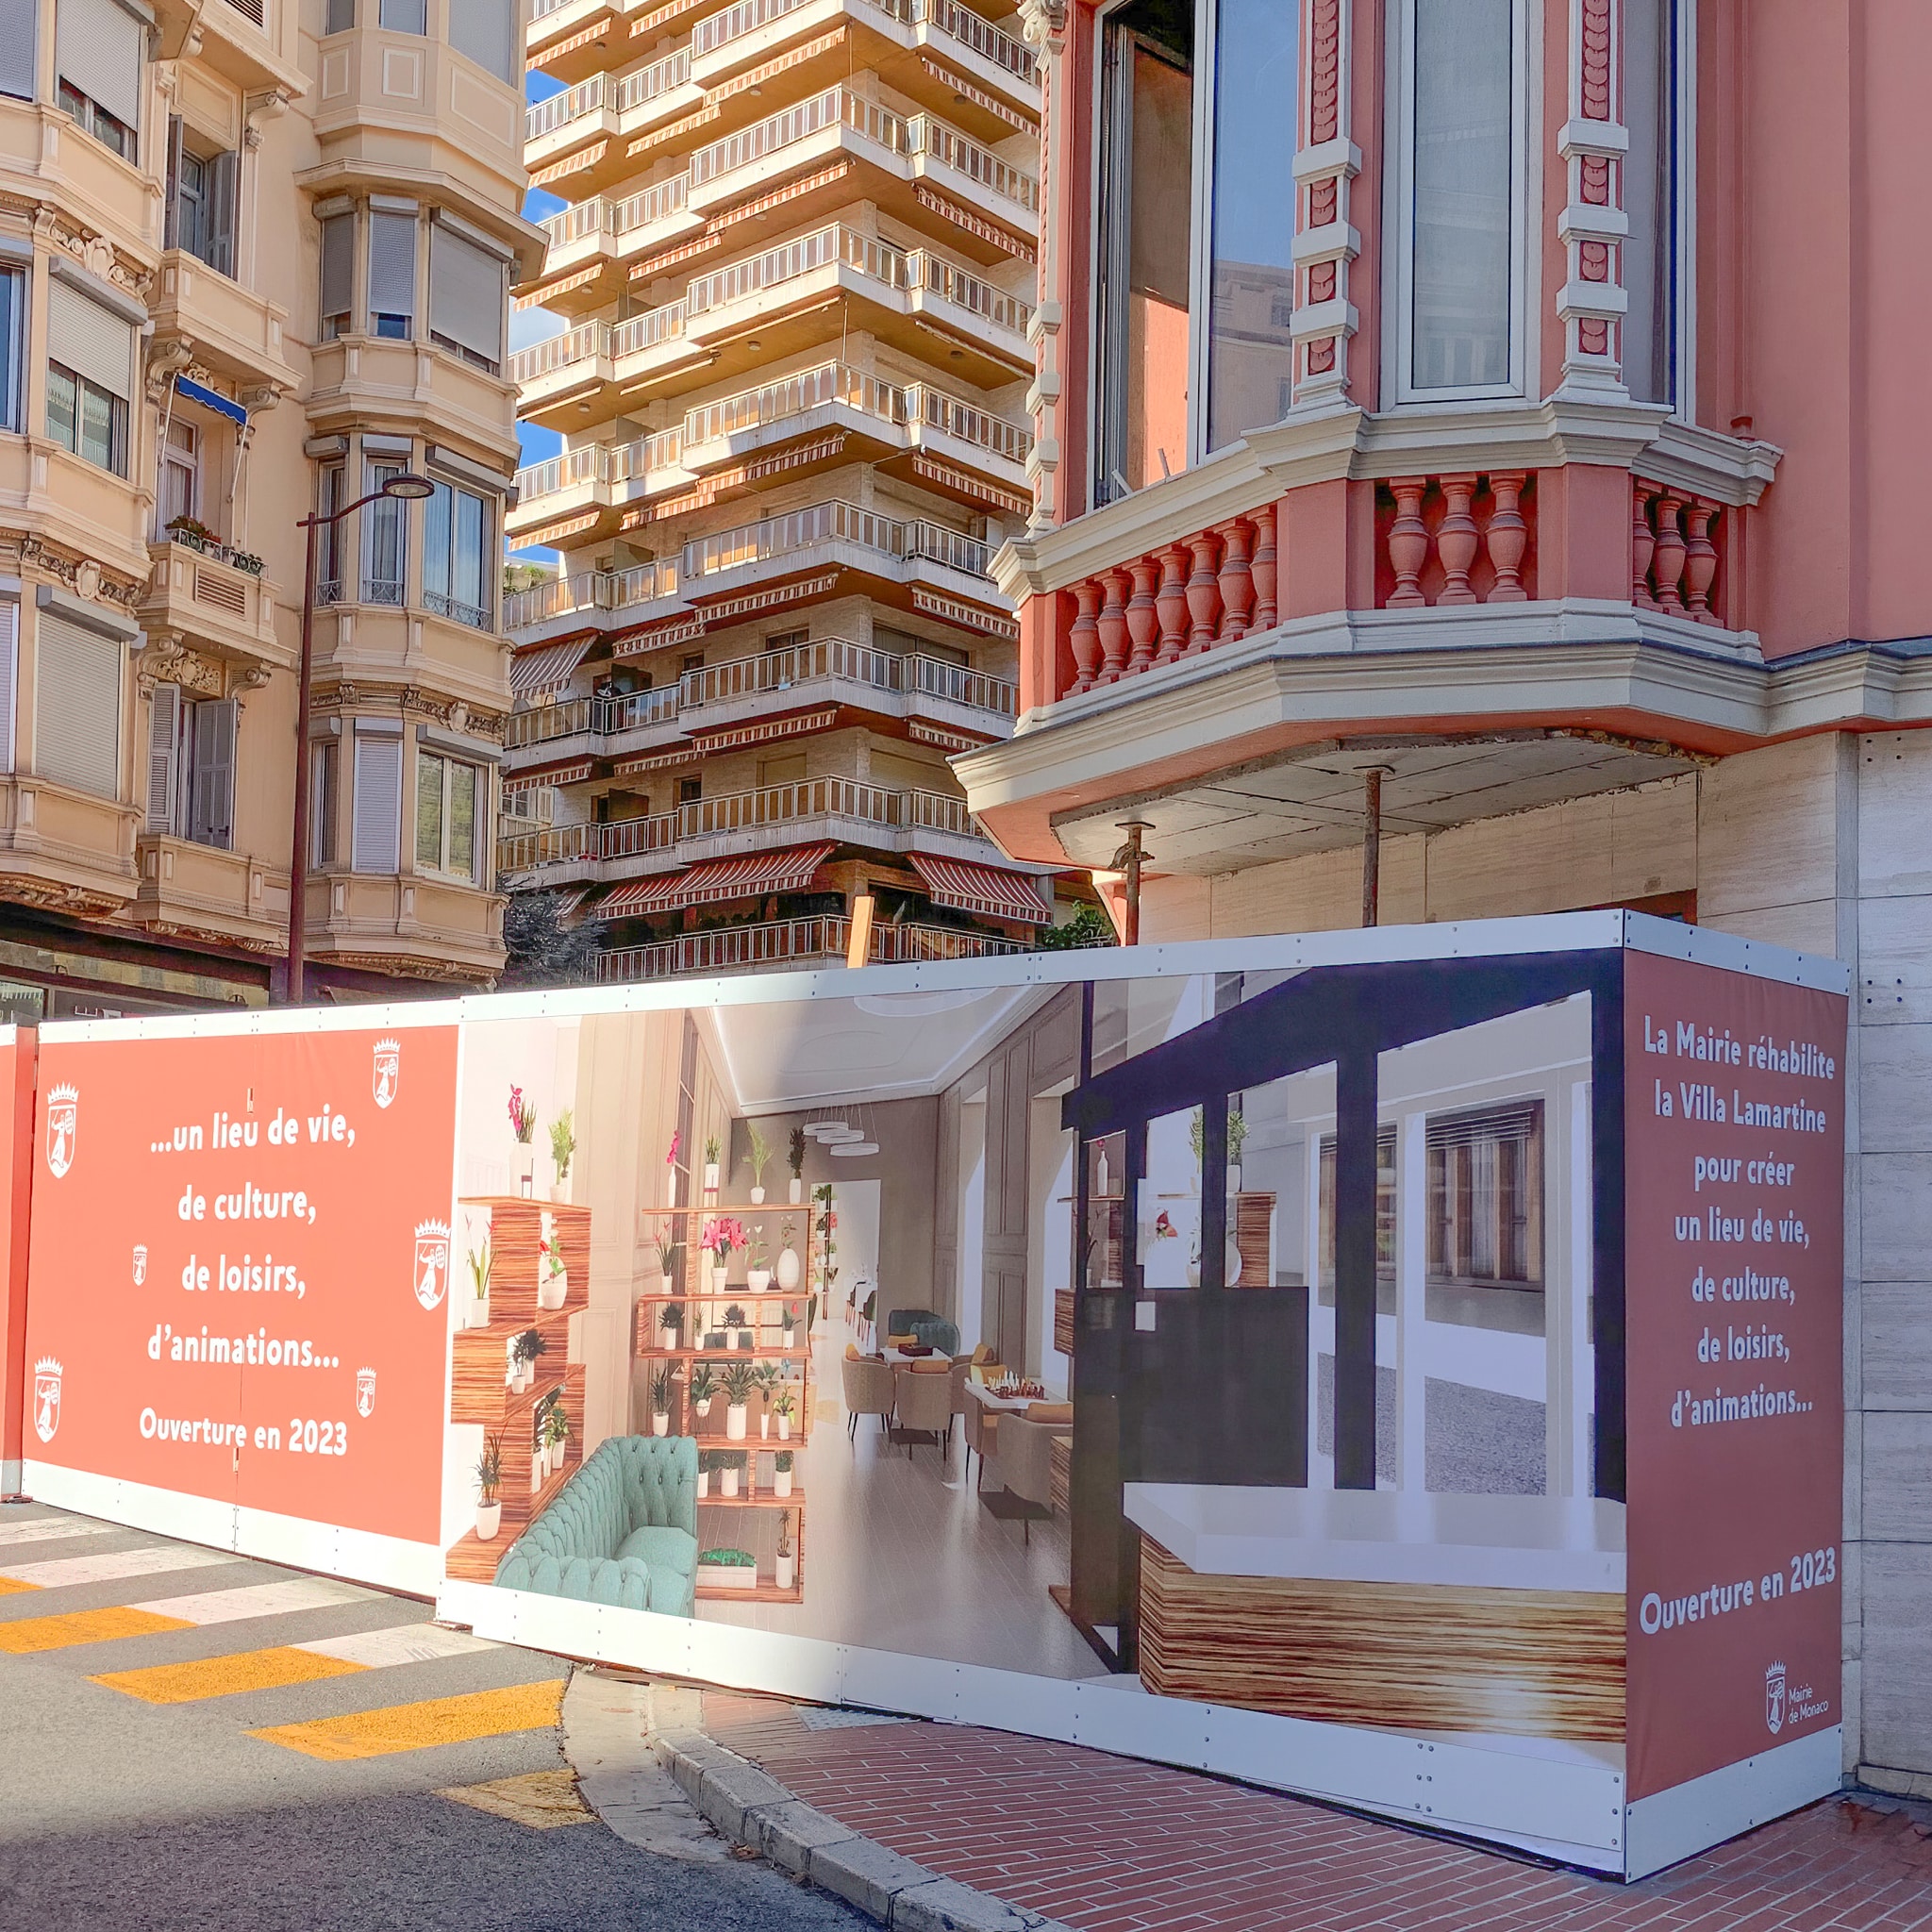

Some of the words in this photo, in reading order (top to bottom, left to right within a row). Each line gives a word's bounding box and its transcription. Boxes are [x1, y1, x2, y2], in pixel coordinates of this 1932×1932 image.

[1644, 1014, 1668, 1055] La
[1676, 1020, 1741, 1066] Mairie
[1748, 1035, 1835, 1080] réhabilite
[1655, 1078, 1673, 1117] la
[1679, 1081, 1726, 1123] Villa
[1733, 1089, 1826, 1133] Lamartine
[150, 1124, 204, 1153] ...un
[212, 1111, 258, 1149] lieu
[267, 1107, 299, 1145] de
[307, 1103, 356, 1148] vie,
[1694, 1156, 1742, 1192] pour
[1747, 1151, 1795, 1186] créer
[177, 1184, 207, 1221] de
[214, 1181, 316, 1225] culture,
[1674, 1216, 1701, 1241] un
[1708, 1206, 1745, 1242] lieu
[1751, 1208, 1774, 1242] de
[1778, 1209, 1809, 1250] vie,
[181, 1254, 210, 1291] de
[218, 1253, 306, 1300] loisirs,
[1691, 1266, 1716, 1302] de
[1722, 1265, 1795, 1307] culture,
[147, 1324, 340, 1368] d'animations...
[1697, 1326, 1722, 1363] de
[1727, 1324, 1790, 1363] loisirs,
[1671, 1383, 1812, 1427] d'animations...
[139, 1407, 247, 1448] Ouverture
[254, 1425, 281, 1450] en
[288, 1418, 347, 1457] 2023
[1640, 1580, 1754, 1635] Ouverture
[1760, 1572, 1784, 1601] en
[1790, 1546, 1836, 1593] 2023
[1788, 1683, 1813, 1706] Mairie
[1788, 1707, 1799, 1724] de
[1799, 1700, 1829, 1722] Monaco
